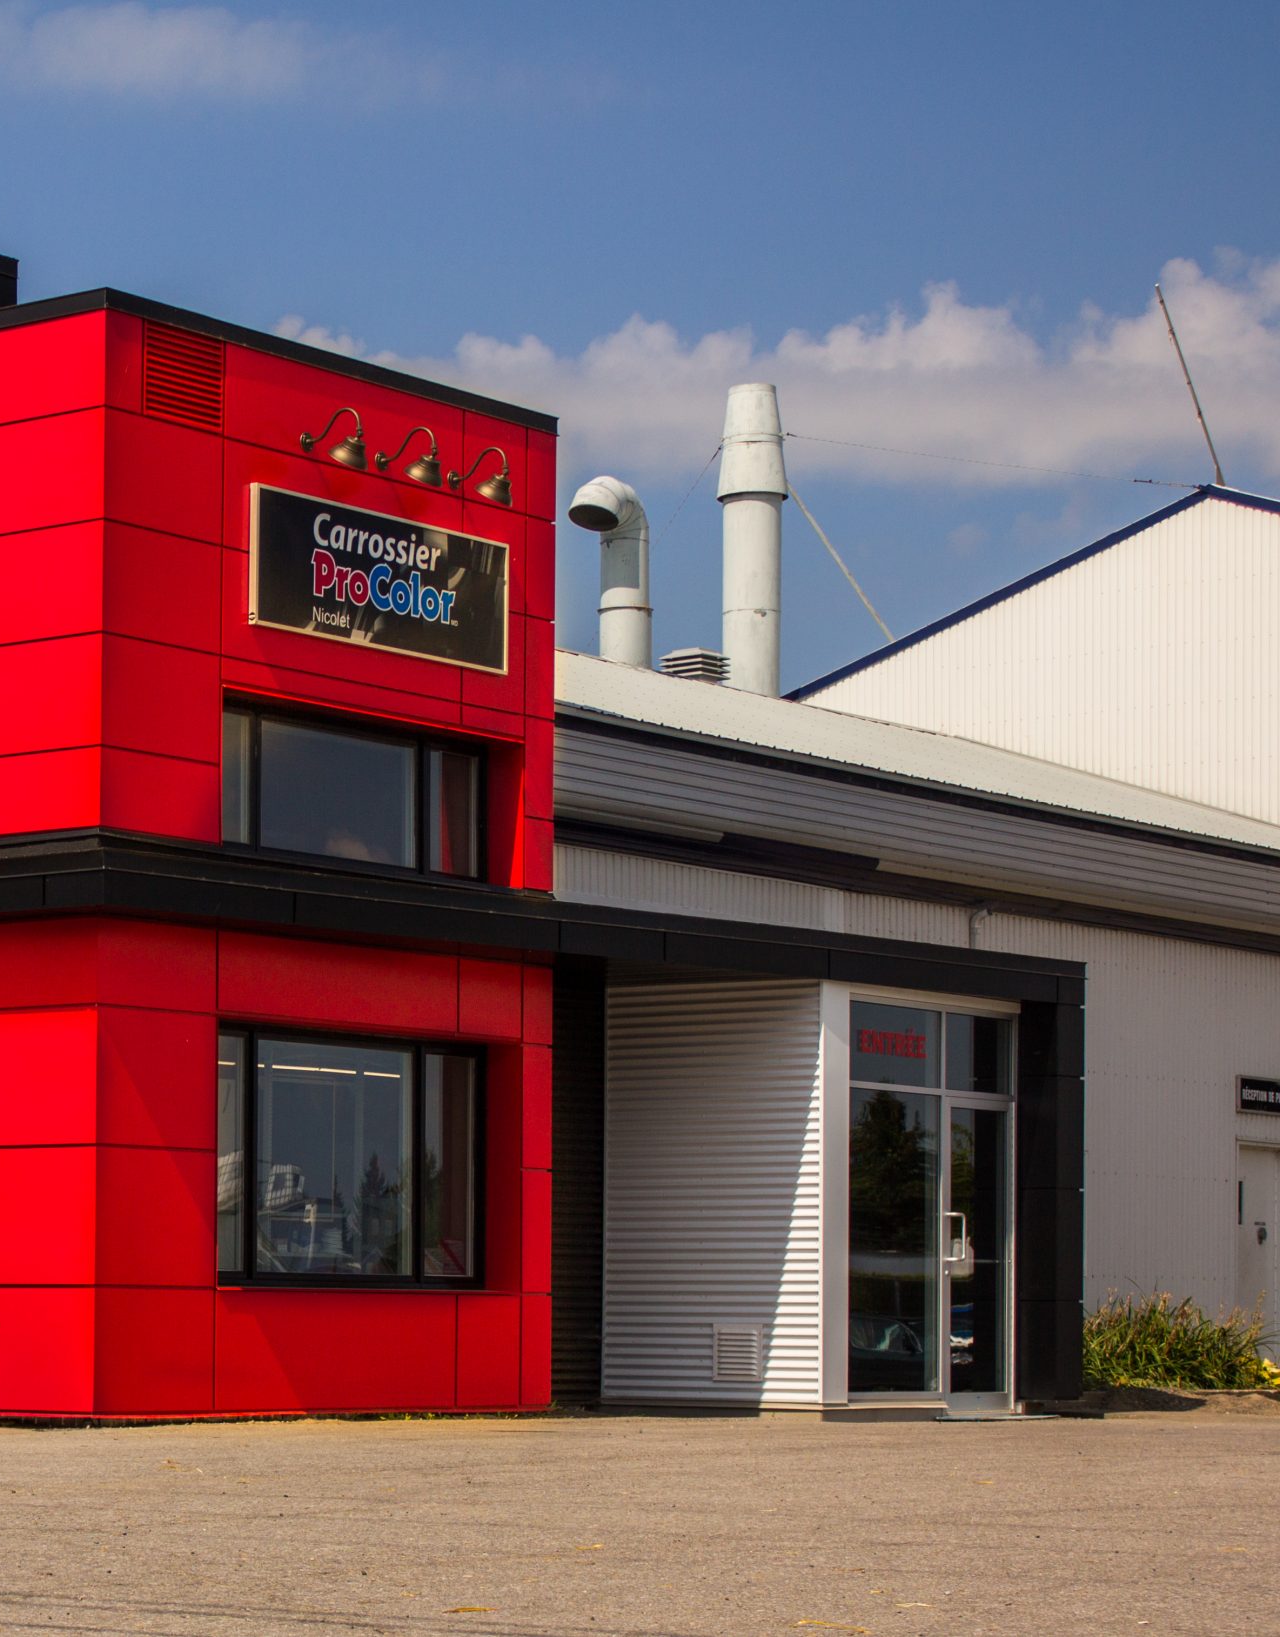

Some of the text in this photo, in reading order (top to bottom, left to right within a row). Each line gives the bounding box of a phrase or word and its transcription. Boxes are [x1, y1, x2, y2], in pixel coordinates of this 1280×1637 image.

[313, 513, 441, 571] Carrossier
[311, 548, 456, 625] ProColor
[312, 606, 350, 628] Nicolet
[859, 1026, 927, 1059] ENTRÉE
